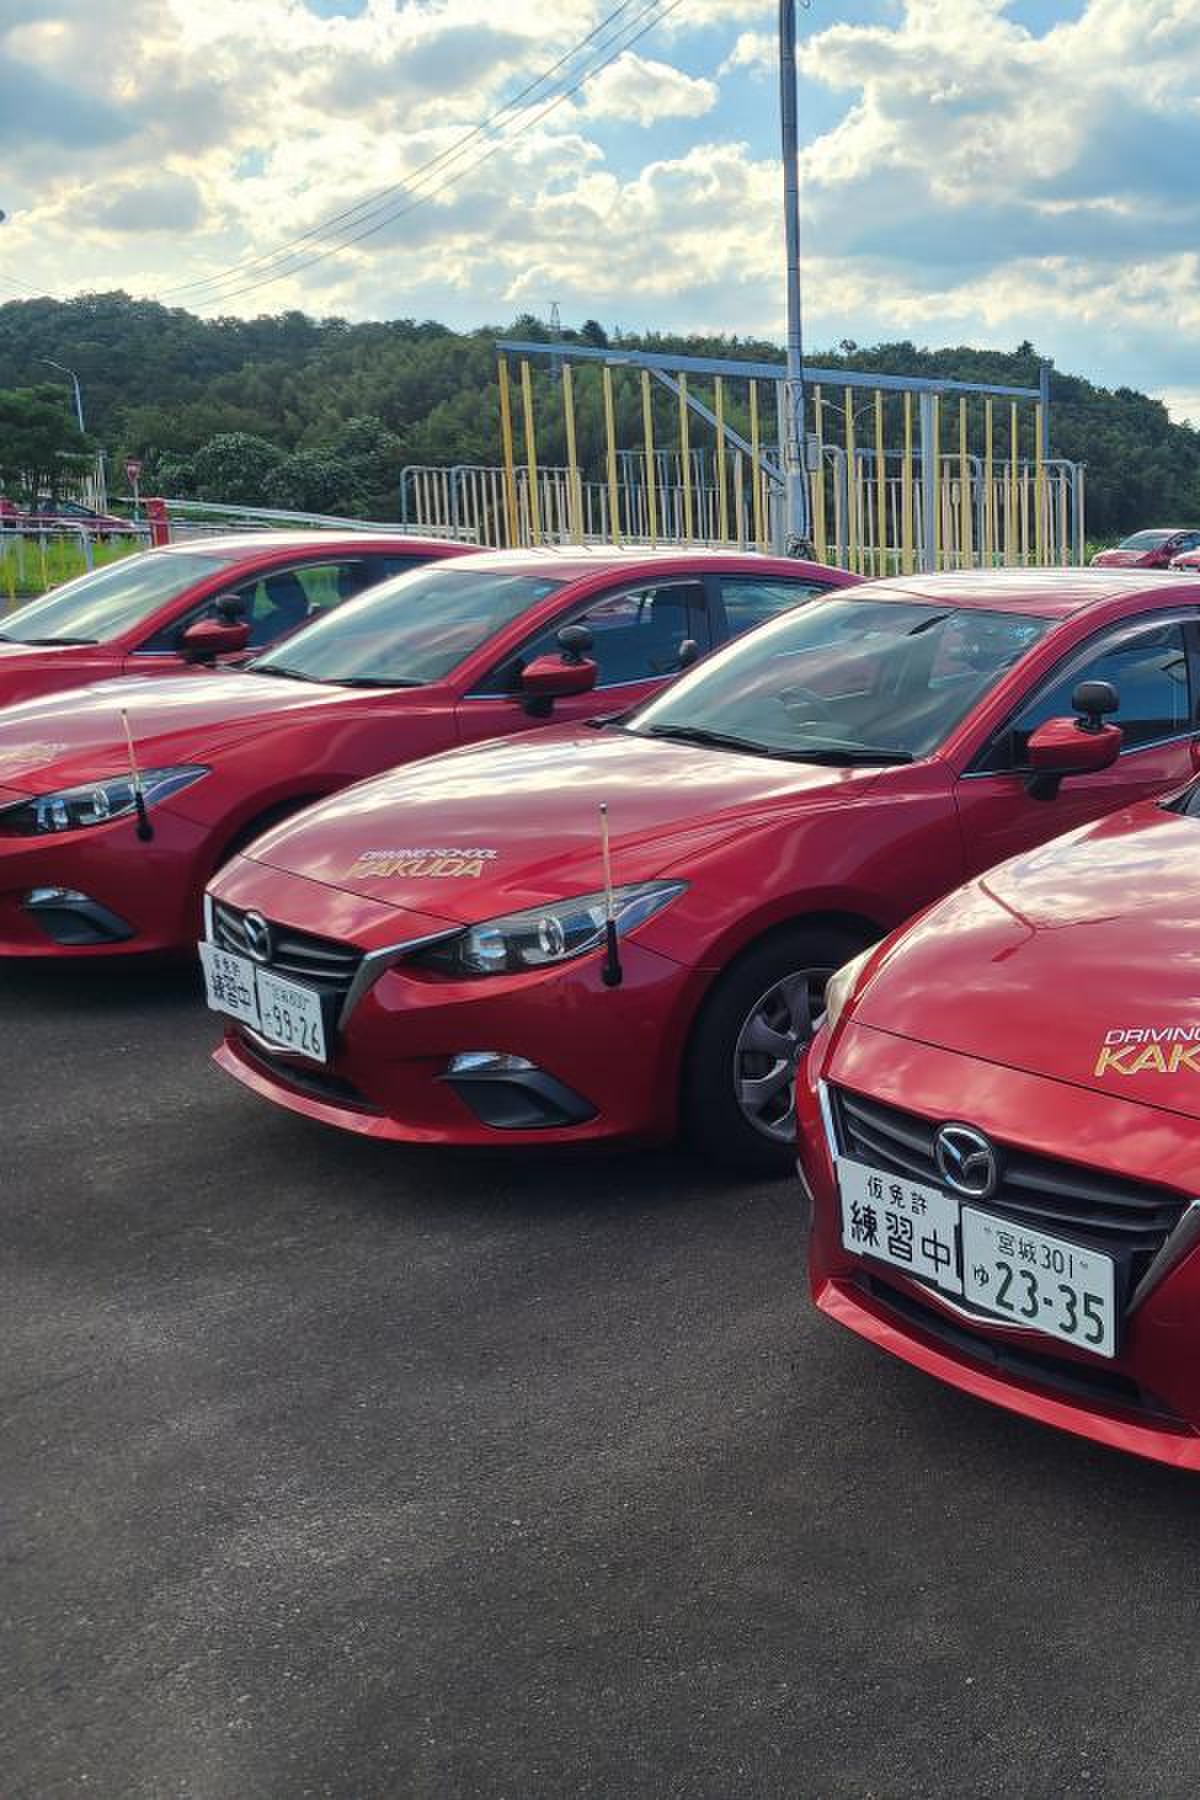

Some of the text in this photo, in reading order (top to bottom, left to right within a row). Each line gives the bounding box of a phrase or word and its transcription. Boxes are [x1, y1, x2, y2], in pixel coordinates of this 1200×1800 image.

[867, 1174, 928, 1215] 仮免許
[850, 1200, 951, 1273] 練習中
[995, 1262, 1105, 1345] 23-35
